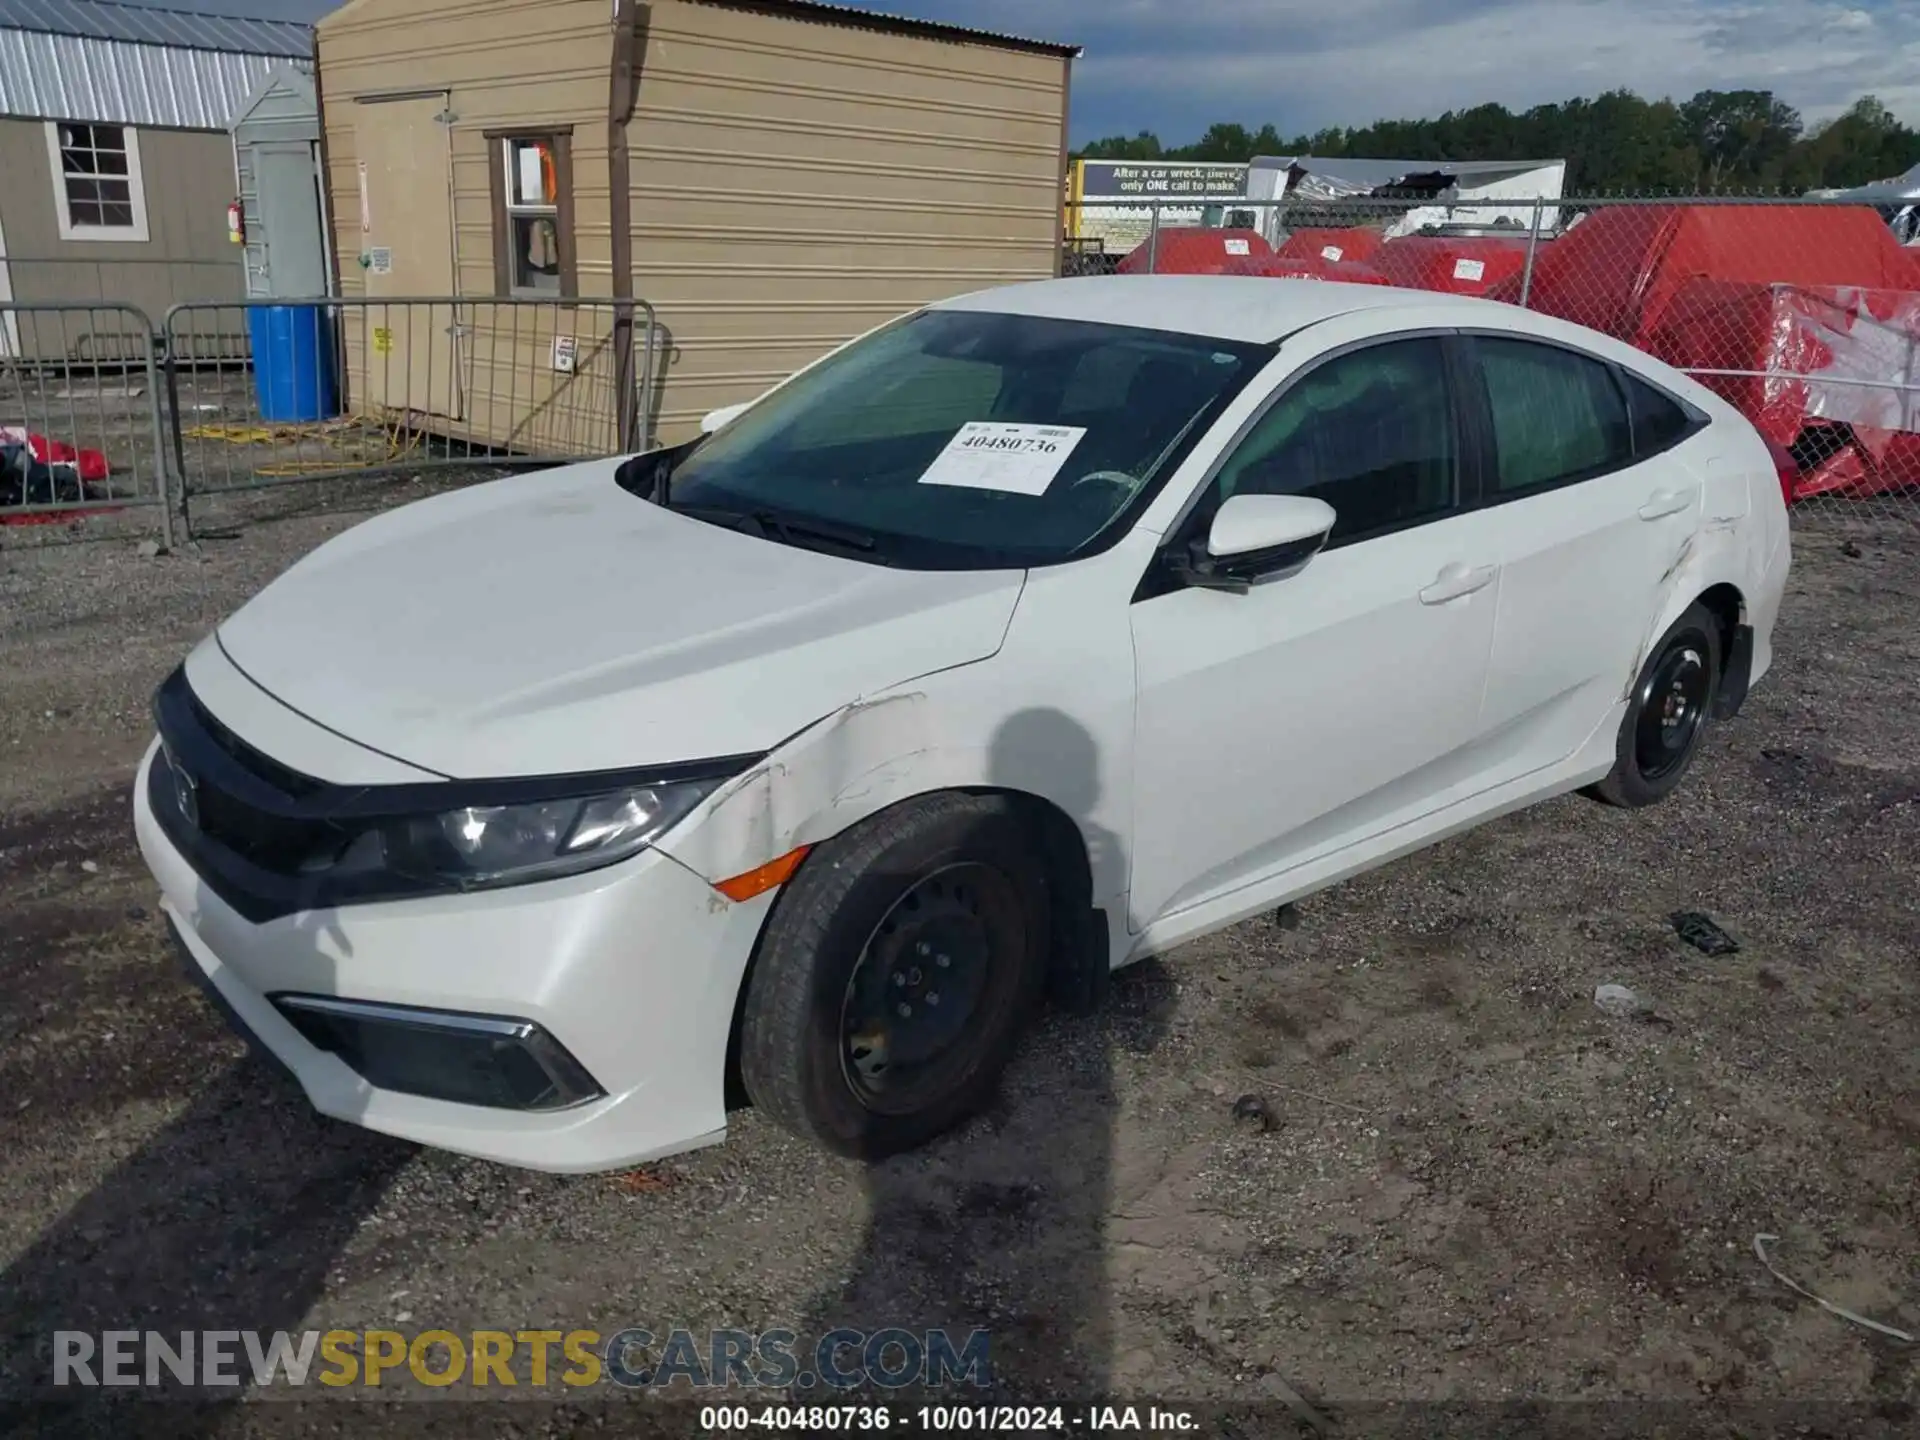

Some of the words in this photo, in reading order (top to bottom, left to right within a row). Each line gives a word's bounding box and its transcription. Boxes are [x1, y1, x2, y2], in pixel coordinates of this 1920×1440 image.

[1113, 168, 1141, 179] After
[1142, 170, 1148, 179] a
[1151, 170, 1167, 179] car
[1170, 168, 1205, 180] wreck,
[1120, 180, 1145, 193] only
[1146, 180, 1169, 191] ONE
[1171, 180, 1190, 191] call
[1193, 181, 1204, 191] to
[961, 435, 1058, 454] 40480736
